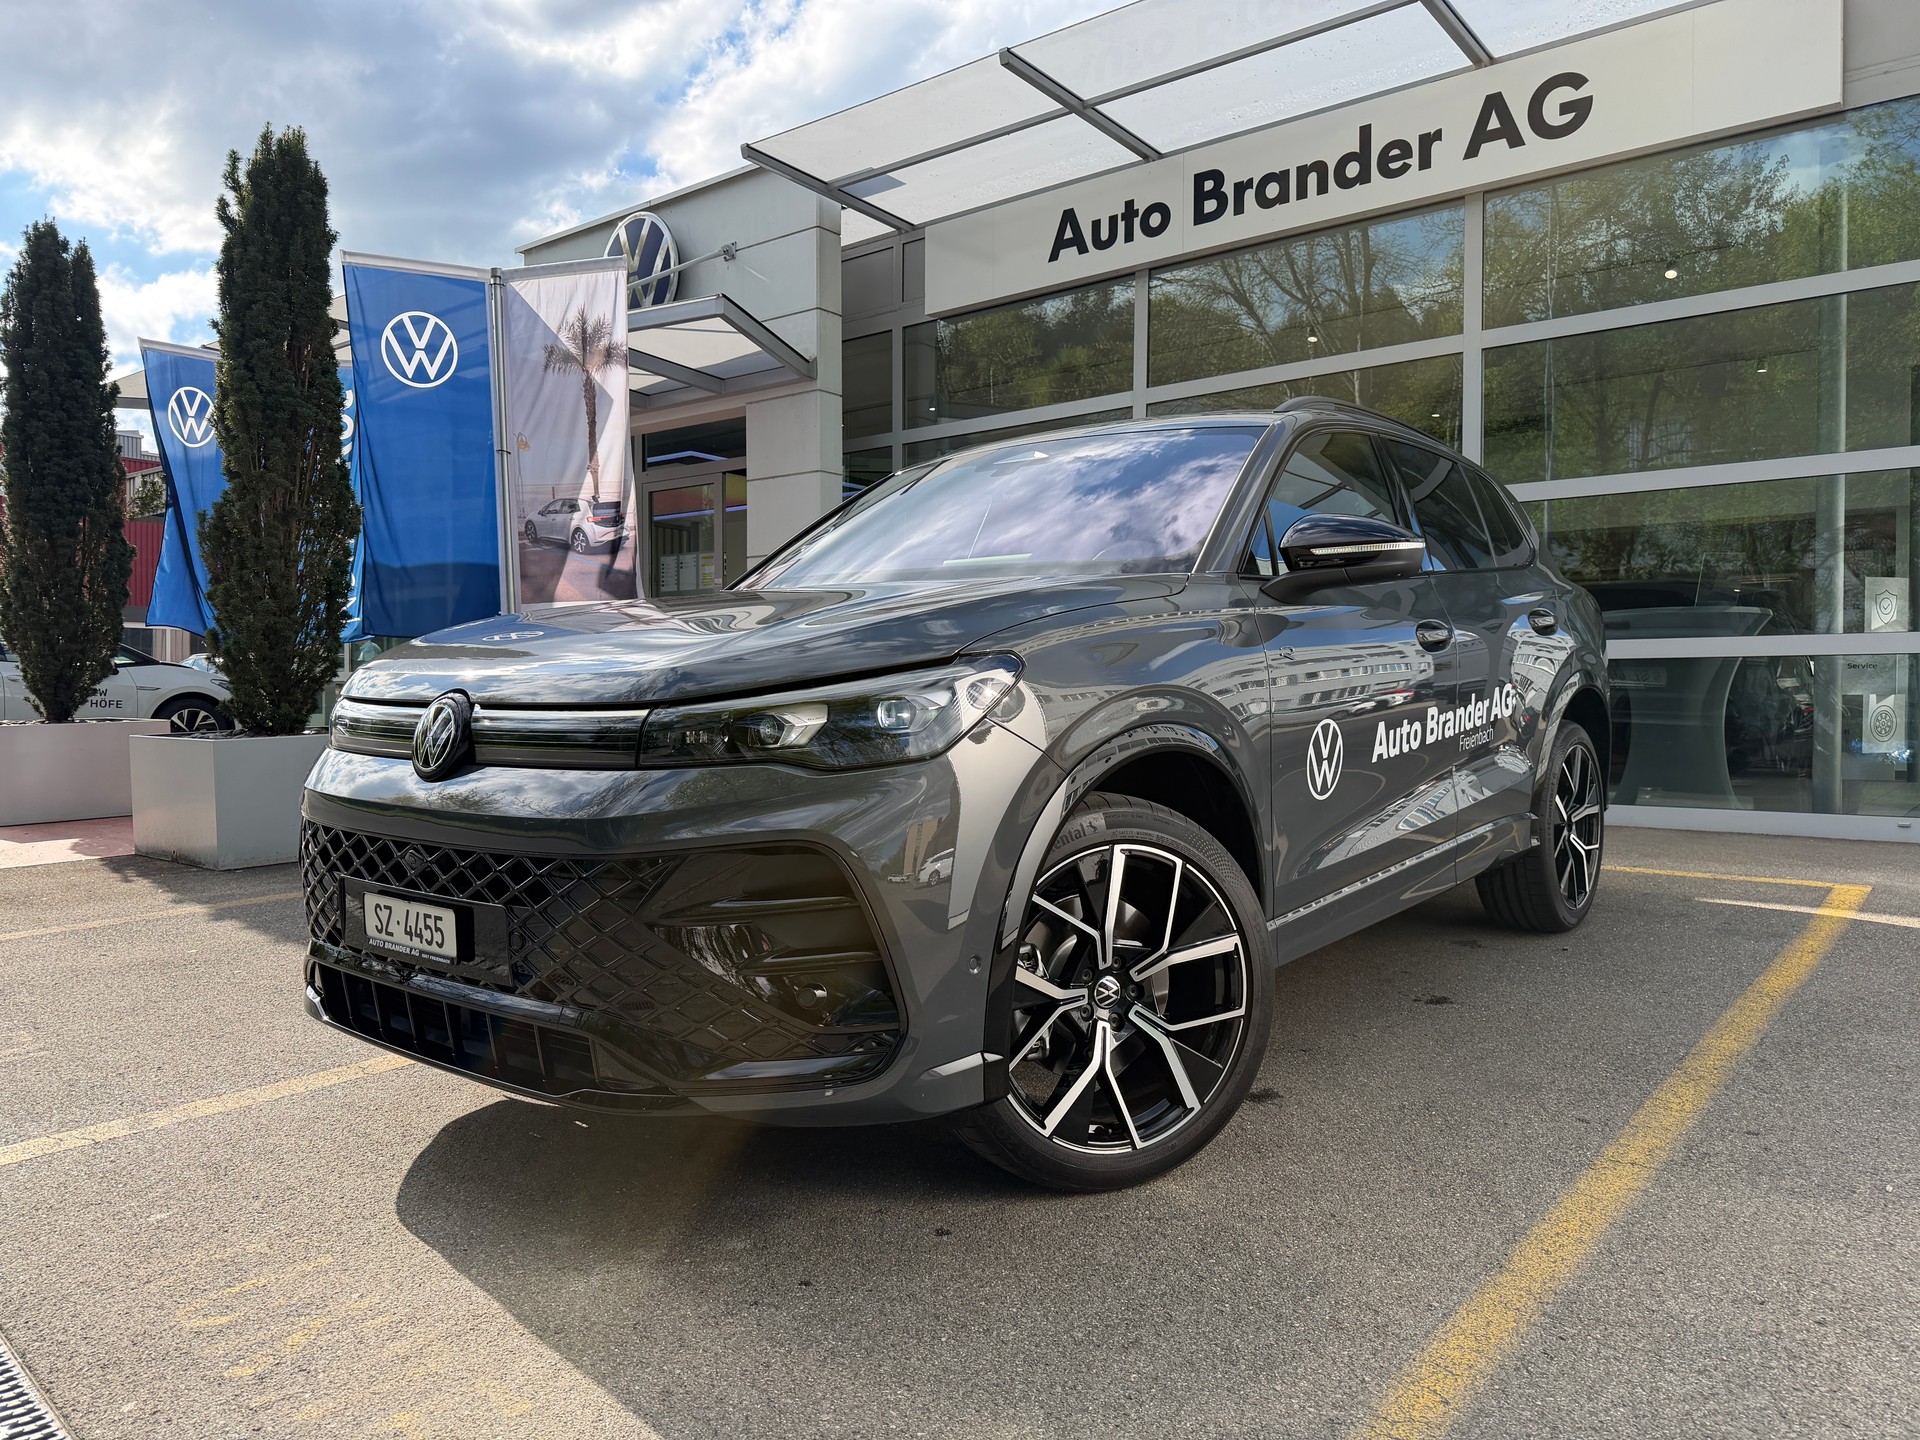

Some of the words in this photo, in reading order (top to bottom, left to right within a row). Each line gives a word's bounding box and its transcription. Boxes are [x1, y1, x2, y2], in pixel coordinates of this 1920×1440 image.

[1048, 199, 1171, 263] Auto
[1193, 123, 1443, 226] Brander
[1462, 71, 1594, 161] AG
[1847, 662, 1878, 670] Service
[90, 697, 123, 709] HÖFE
[98, 688, 108, 697] W
[1372, 720, 1422, 763] Auto
[1426, 693, 1489, 745] Brander
[1490, 682, 1513, 722] AG
[1459, 727, 1494, 752] Freienbach
[404, 909, 445, 949] 4455
[368, 938, 384, 947] AUTO
[384, 942, 411, 954] BRANDER
[411, 949, 420, 957] AG
